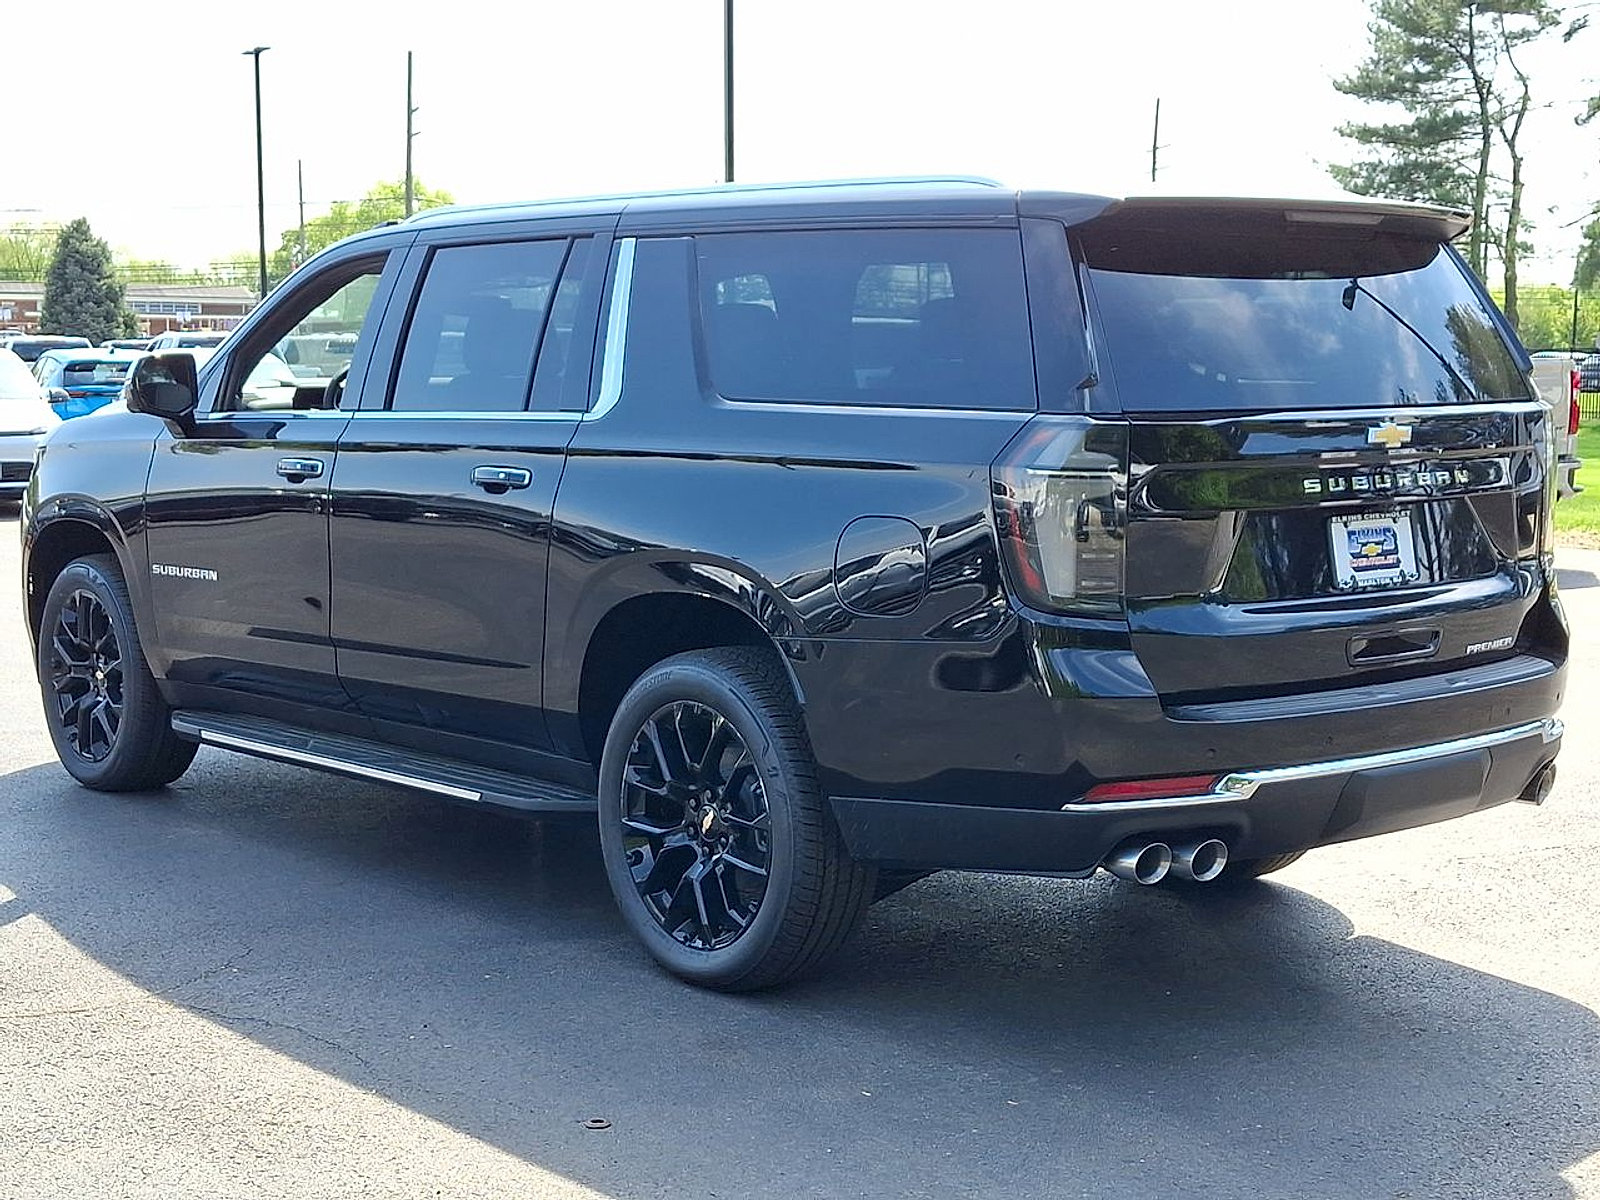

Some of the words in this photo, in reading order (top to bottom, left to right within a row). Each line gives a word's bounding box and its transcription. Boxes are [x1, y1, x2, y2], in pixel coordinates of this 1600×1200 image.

[1303, 470, 1469, 494] SUBURBAN
[1363, 511, 1411, 520] CHEVROLET
[152, 564, 218, 581] SUBURBAN
[1467, 637, 1512, 654] PREMIER
